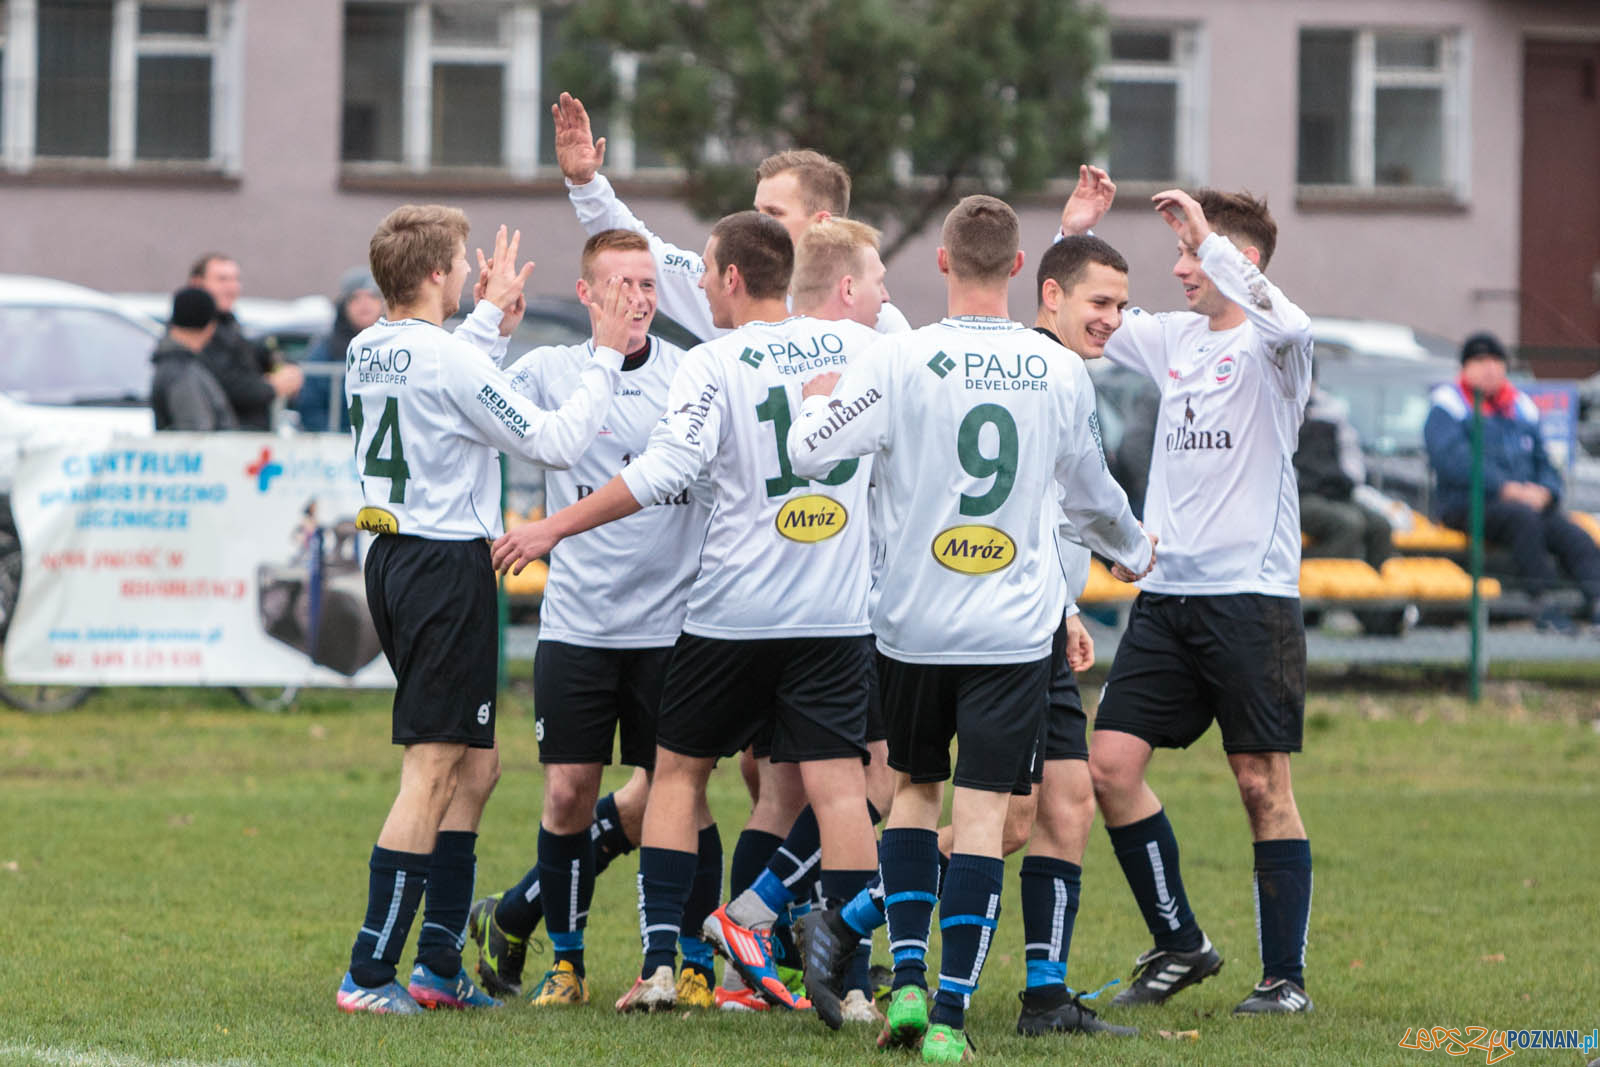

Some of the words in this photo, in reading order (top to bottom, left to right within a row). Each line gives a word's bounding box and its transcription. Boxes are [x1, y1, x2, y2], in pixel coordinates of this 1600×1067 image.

[359, 347, 411, 373] PAJO
[768, 333, 843, 365] PAJO
[778, 355, 847, 375] DEVELOPER
[965, 353, 1048, 379] PAJO
[359, 372, 407, 385] DEVELOPER
[965, 379, 1048, 392] DEVELOPER
[481, 384, 531, 432] REDBOX
[804, 391, 882, 452] Pollana
[348, 394, 411, 504] 14
[756, 385, 859, 497] 1
[1166, 426, 1233, 452] ollana
[957, 403, 1019, 517] 9
[784, 506, 835, 528] Mróz
[942, 538, 1005, 560] Mróz
